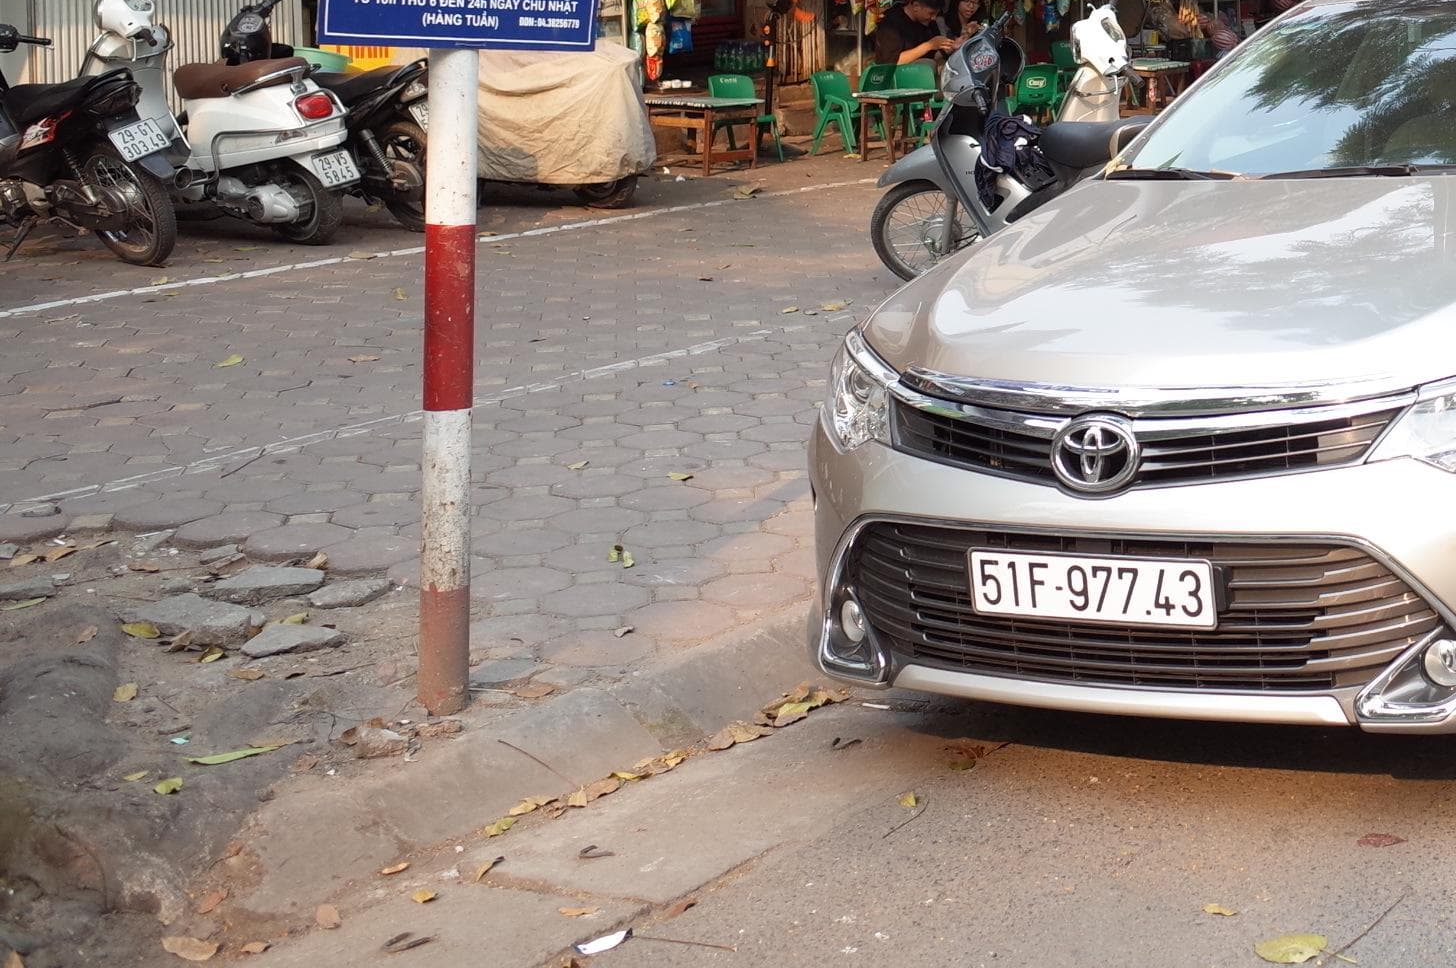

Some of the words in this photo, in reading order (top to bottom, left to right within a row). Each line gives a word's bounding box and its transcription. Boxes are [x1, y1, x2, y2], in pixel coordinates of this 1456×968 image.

[422, 10, 463, 26] (HÀNG
[118, 122, 153, 144] 29-G1
[123, 133, 166, 158] 303.49
[318, 152, 347, 171] 29-V5
[325, 166, 354, 184] 5845
[980, 559, 1203, 618] 51F-977.43
